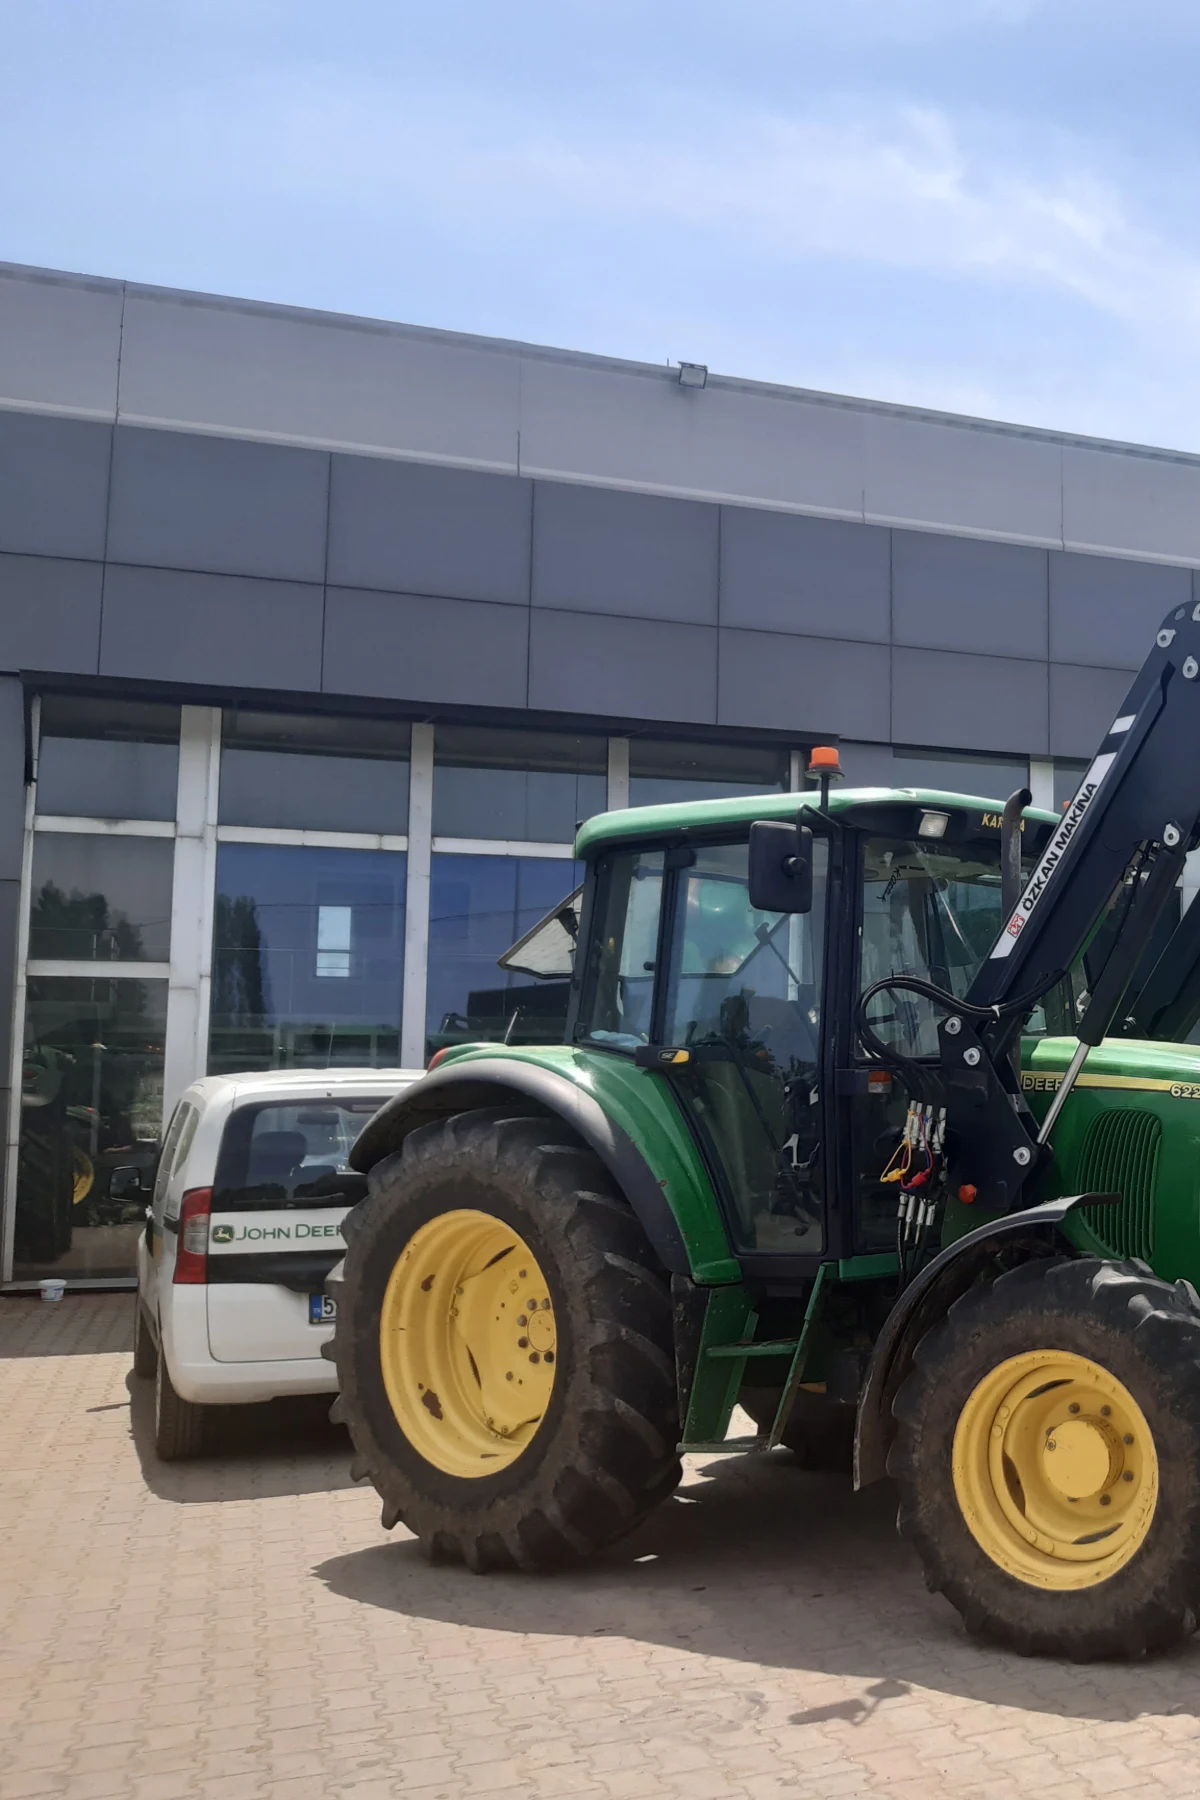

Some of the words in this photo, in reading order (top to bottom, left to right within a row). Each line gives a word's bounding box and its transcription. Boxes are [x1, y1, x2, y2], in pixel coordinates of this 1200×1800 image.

[1022, 849, 1059, 912] ÖZKAN
[1059, 783, 1098, 851] MAKİNA
[236, 1226, 291, 1241] JOHN
